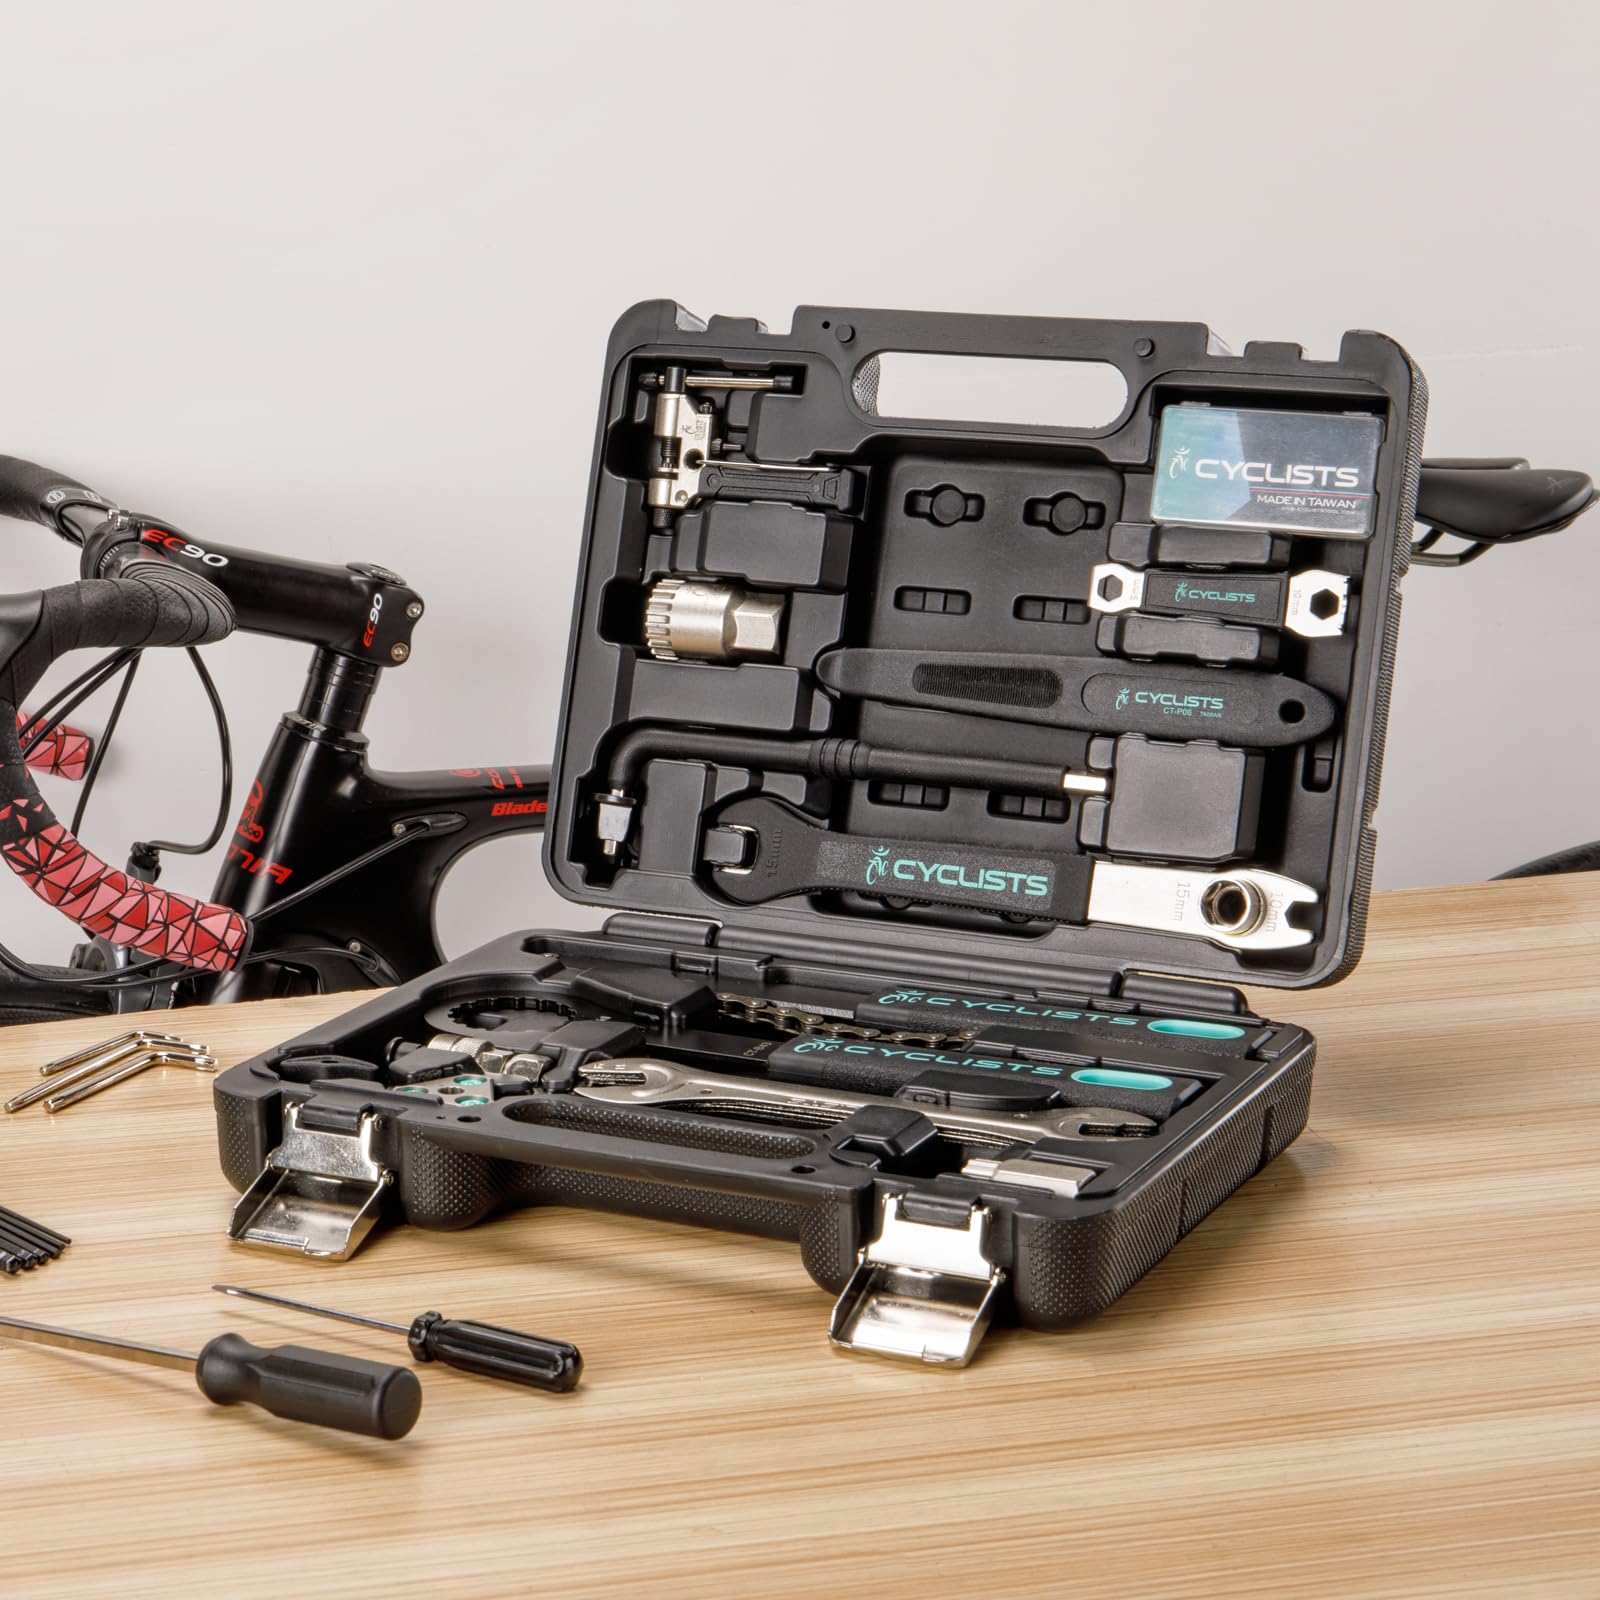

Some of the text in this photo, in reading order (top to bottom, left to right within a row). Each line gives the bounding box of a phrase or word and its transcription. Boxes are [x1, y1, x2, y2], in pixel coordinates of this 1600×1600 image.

[1194, 458, 1359, 488] CYCLISTS
[1256, 494, 1357, 509] MADE IN TAIWAN
[142, 528, 229, 567] EC90
[1188, 589, 1256, 603] CYCLISTS
[363, 592, 383, 648] EC90
[1135, 691, 1224, 709] CYCLISTS
[490, 799, 548, 817] Blade
[892, 858, 1049, 897] CYCLISTS
[1173, 881, 1191, 921] 15mm
[1264, 890, 1284, 932] 10mm
[926, 997, 1140, 1027] CYCLISTS
[843, 1044, 1064, 1077] CYCLISTS
